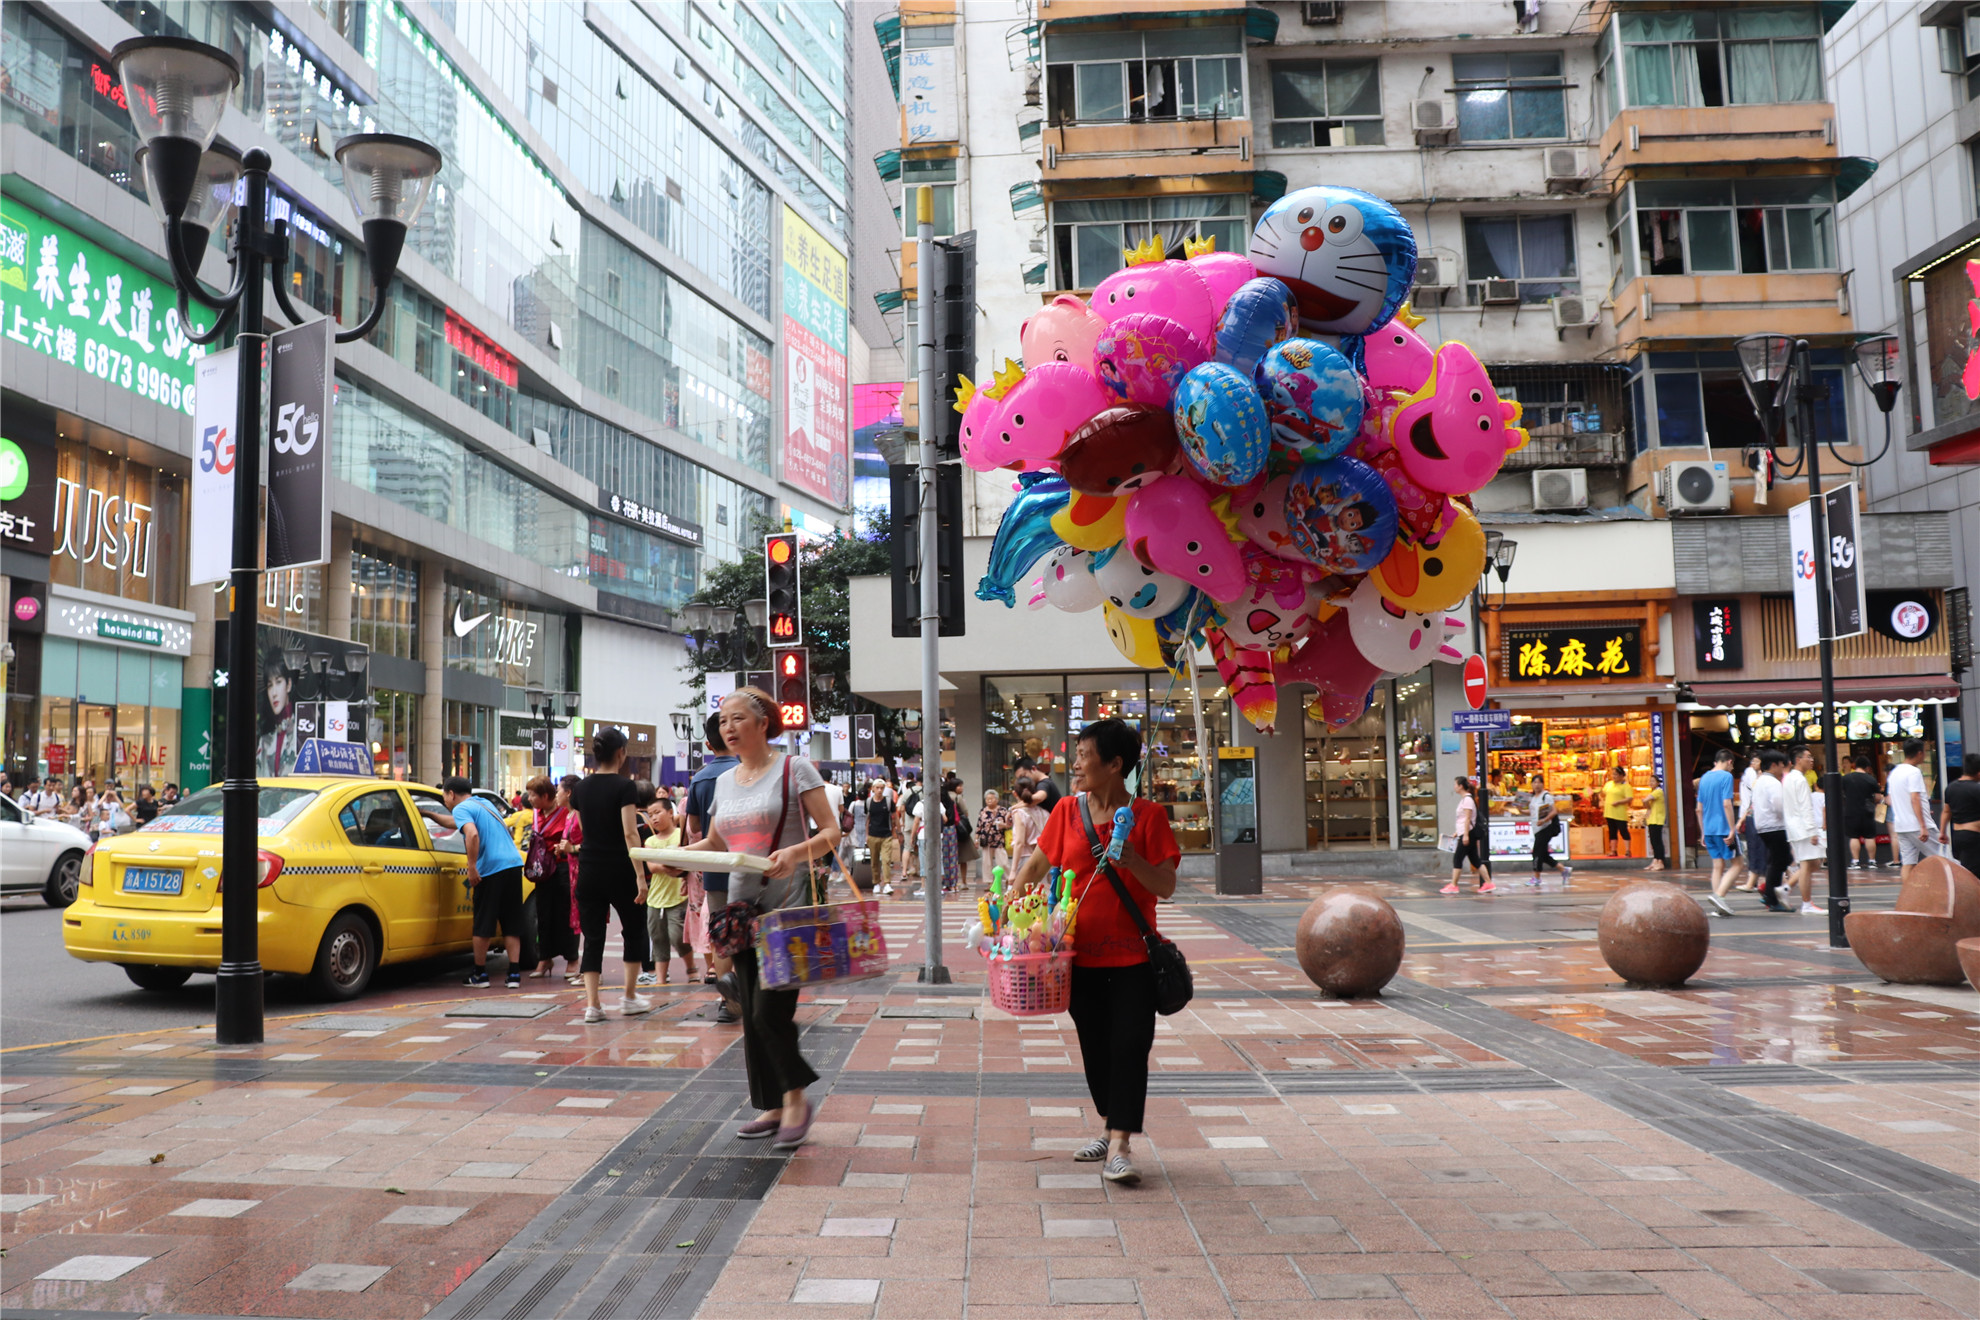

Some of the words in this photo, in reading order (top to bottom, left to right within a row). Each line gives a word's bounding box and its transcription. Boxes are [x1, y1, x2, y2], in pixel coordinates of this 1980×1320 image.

[797, 234, 845, 302] 养生足道
[84, 337, 133, 389] 6873
[137, 361, 181, 410] 9966
[274, 402, 320, 456] 5G
[53, 477, 152, 578] JUST
[1831, 535, 1855, 568] 5G
[1796, 549, 1816, 580] 5G
[104, 622, 143, 640] hotwind
[774, 617, 793, 636] 46
[1517, 636, 1631, 677] 陈麻花
[782, 705, 804, 725] 28
[298, 719, 315, 733] 5G
[328, 719, 345, 732] 5G
[833, 730, 847, 740] 5G
[858, 728, 872, 740] 5G
[534, 740, 546, 750] 5G
[555, 740, 568, 750] 5G
[130, 745, 167, 766] SALE
